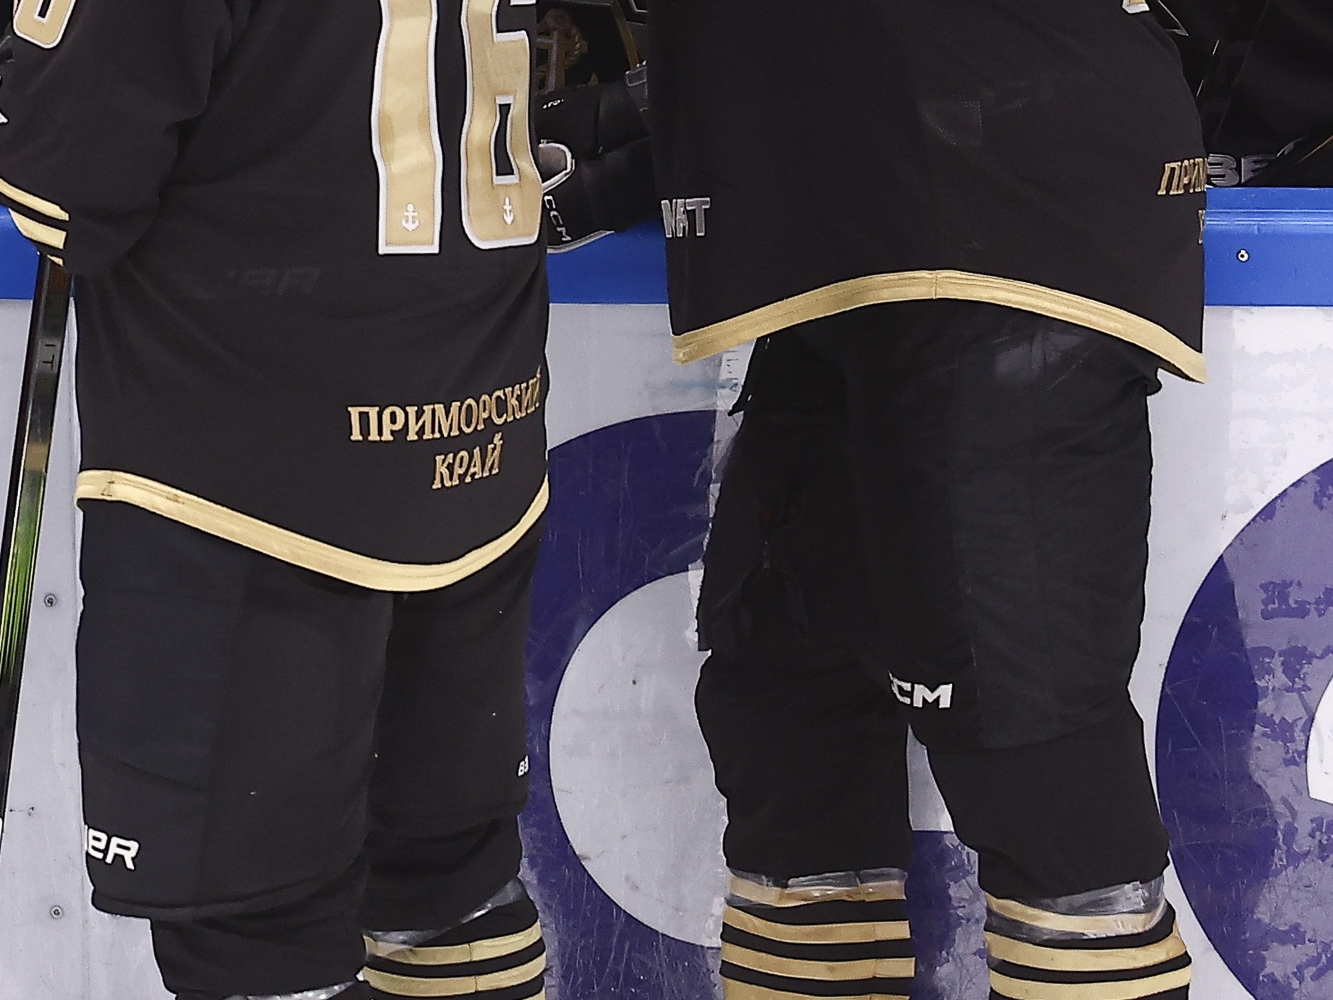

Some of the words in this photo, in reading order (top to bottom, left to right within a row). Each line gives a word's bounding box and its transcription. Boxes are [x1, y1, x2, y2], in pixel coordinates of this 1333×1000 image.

[543, 195, 573, 242] CCM
[347, 365, 542, 442] ПРИМОРСКИЙ
[431, 431, 504, 490] КРАЙ
[888, 670, 953, 709] CM
